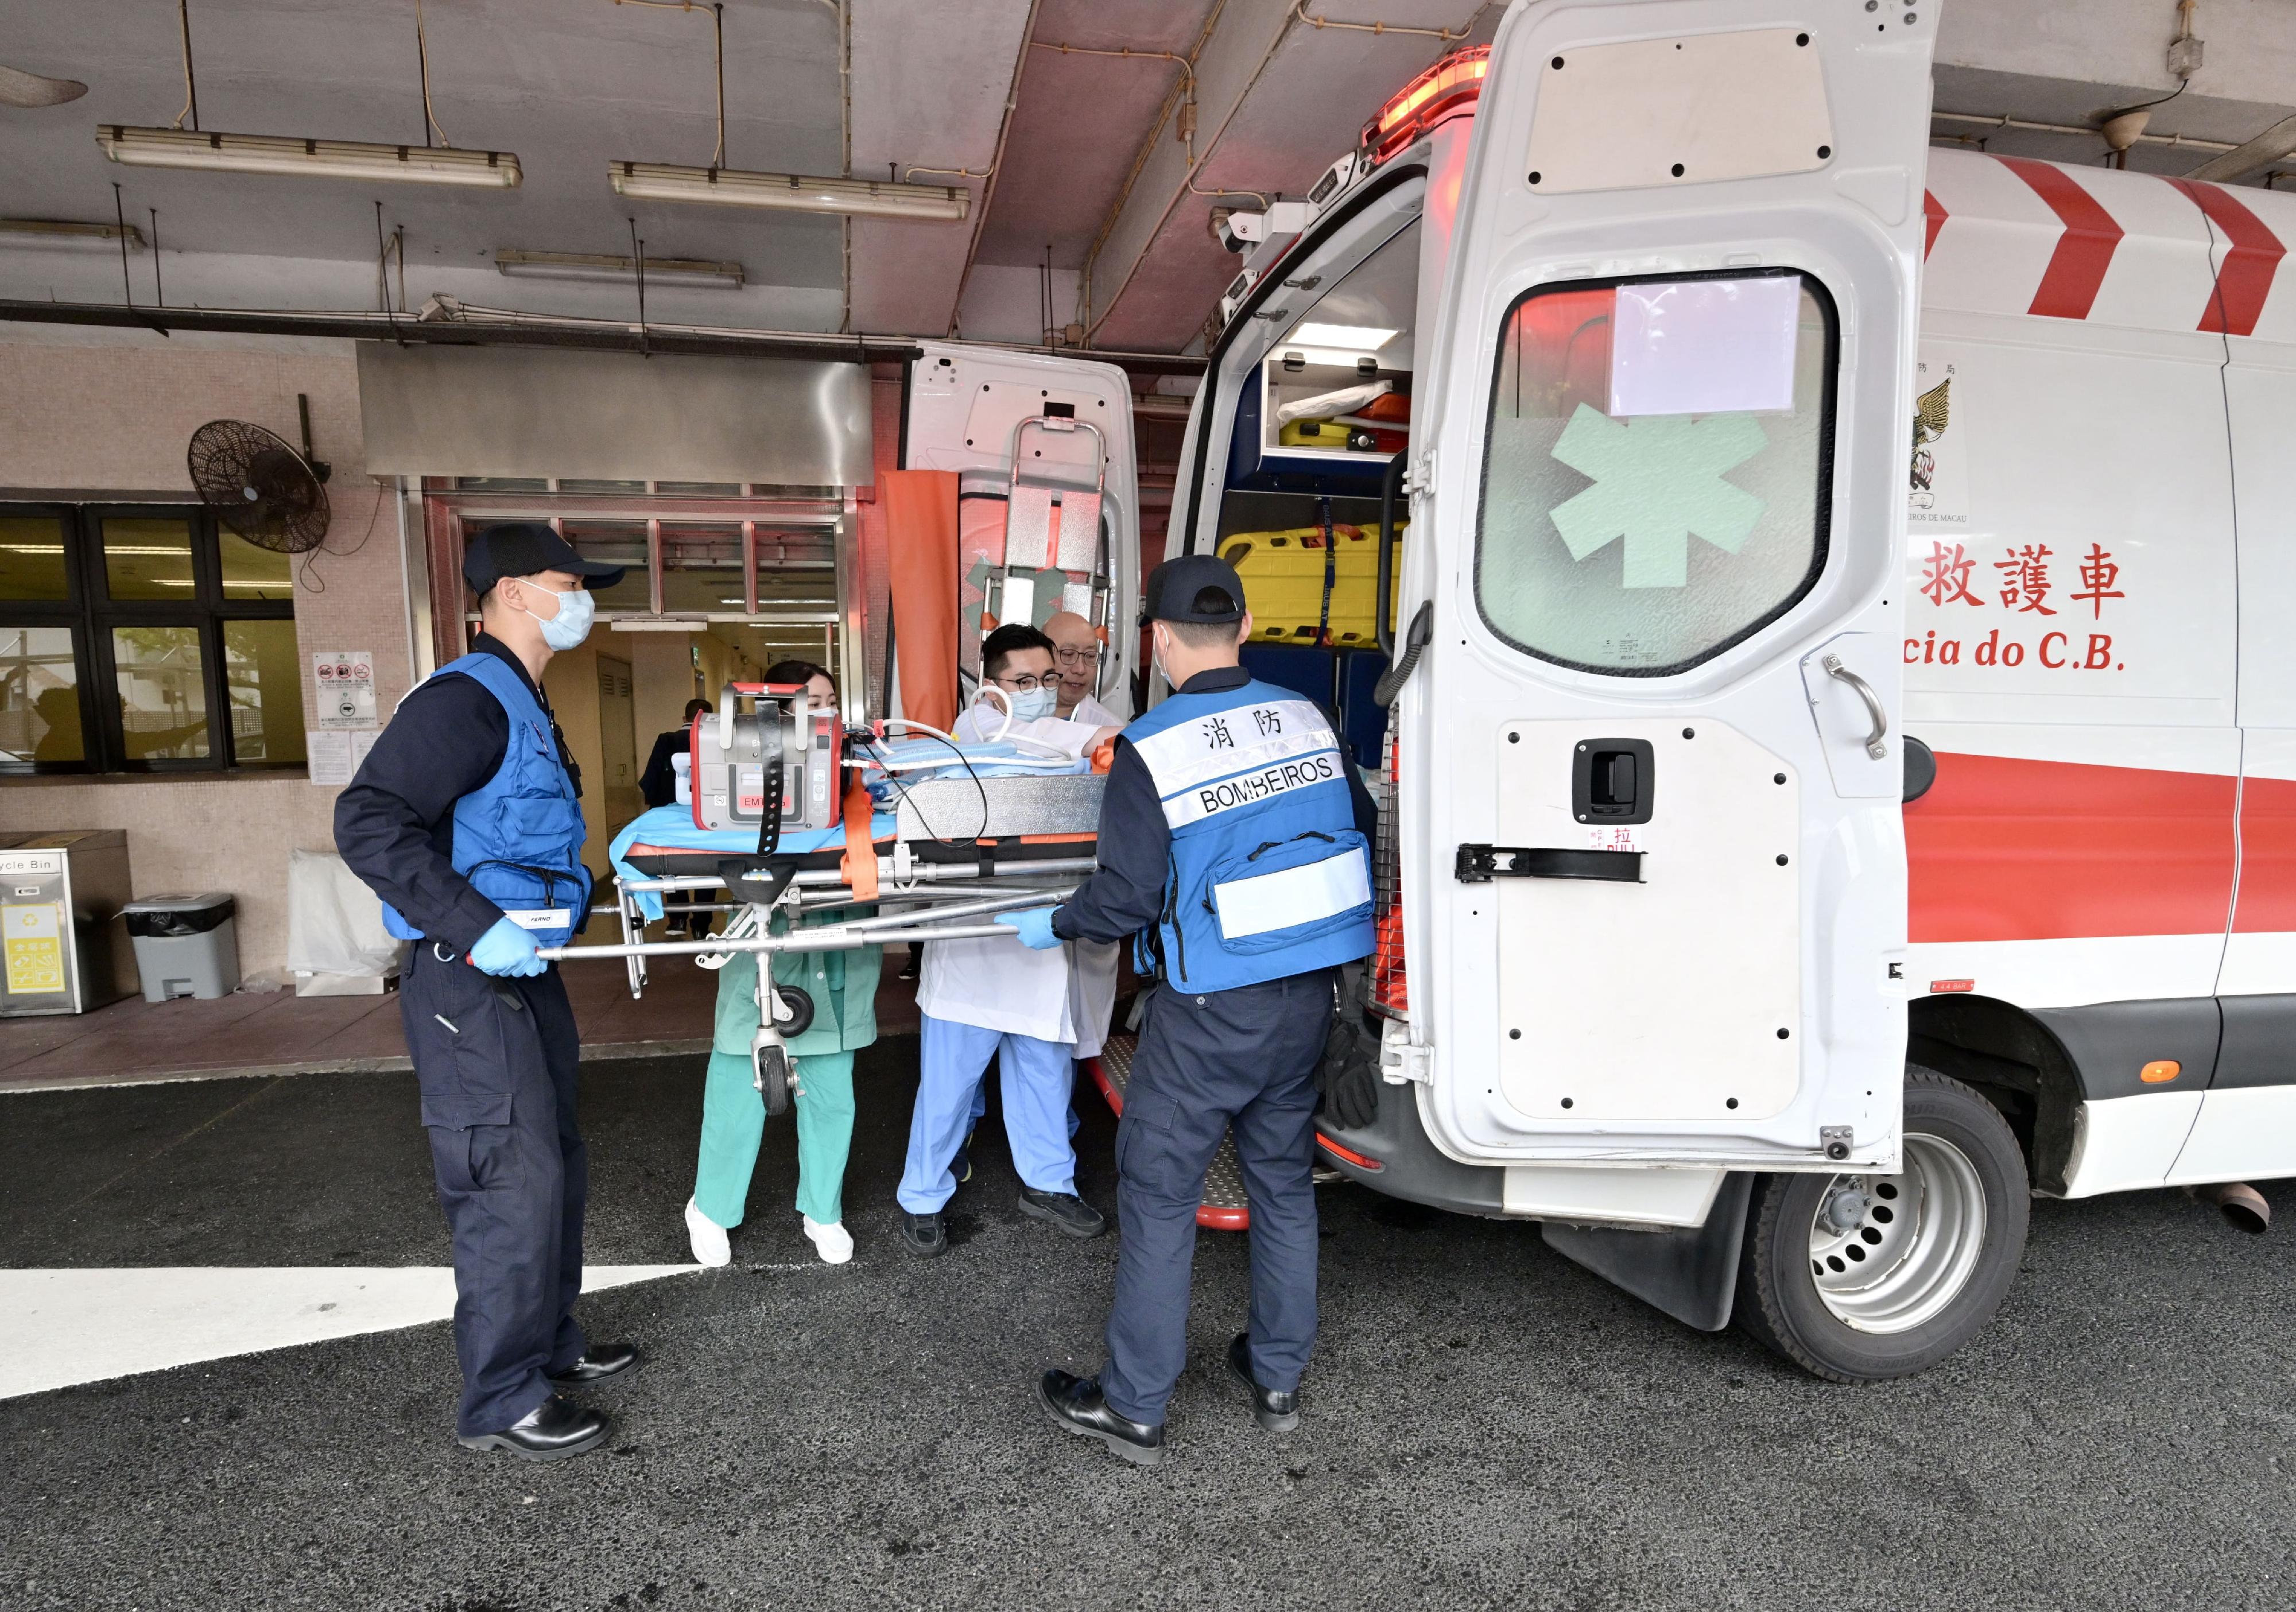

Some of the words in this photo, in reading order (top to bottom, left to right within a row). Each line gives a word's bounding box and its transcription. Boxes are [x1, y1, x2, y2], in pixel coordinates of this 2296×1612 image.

[1940, 514, 1967, 522] MACAU
[1920, 541, 2125, 621] 救護車
[1975, 629, 2024, 667] do
[2039, 631, 2124, 671] C.B.
[1202, 710, 1282, 750] 消防
[1200, 757, 1333, 813] BOMBEIROS
[1614, 828, 1631, 843] 拉
[30, 860, 51, 869] Bin
